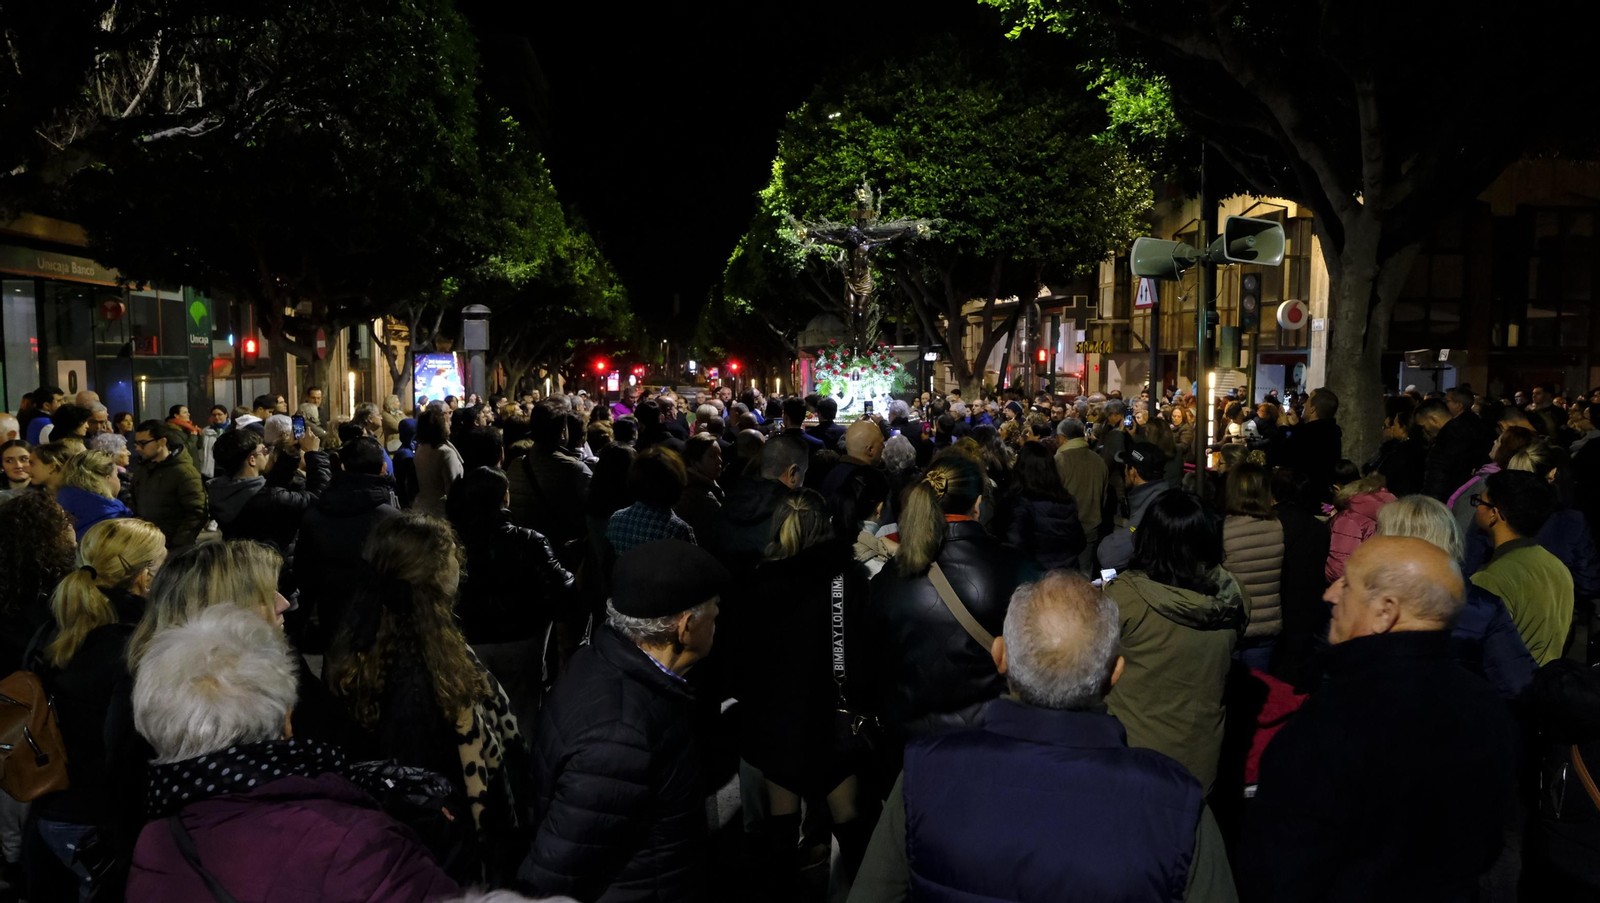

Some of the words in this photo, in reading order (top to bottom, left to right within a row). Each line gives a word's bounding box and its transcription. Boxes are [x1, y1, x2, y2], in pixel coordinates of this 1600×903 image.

[37, 257, 70, 275] Unicaja
[71, 261, 95, 276] Banco
[190, 333, 209, 346] Unicaja
[833, 601, 843, 628] LOLA
